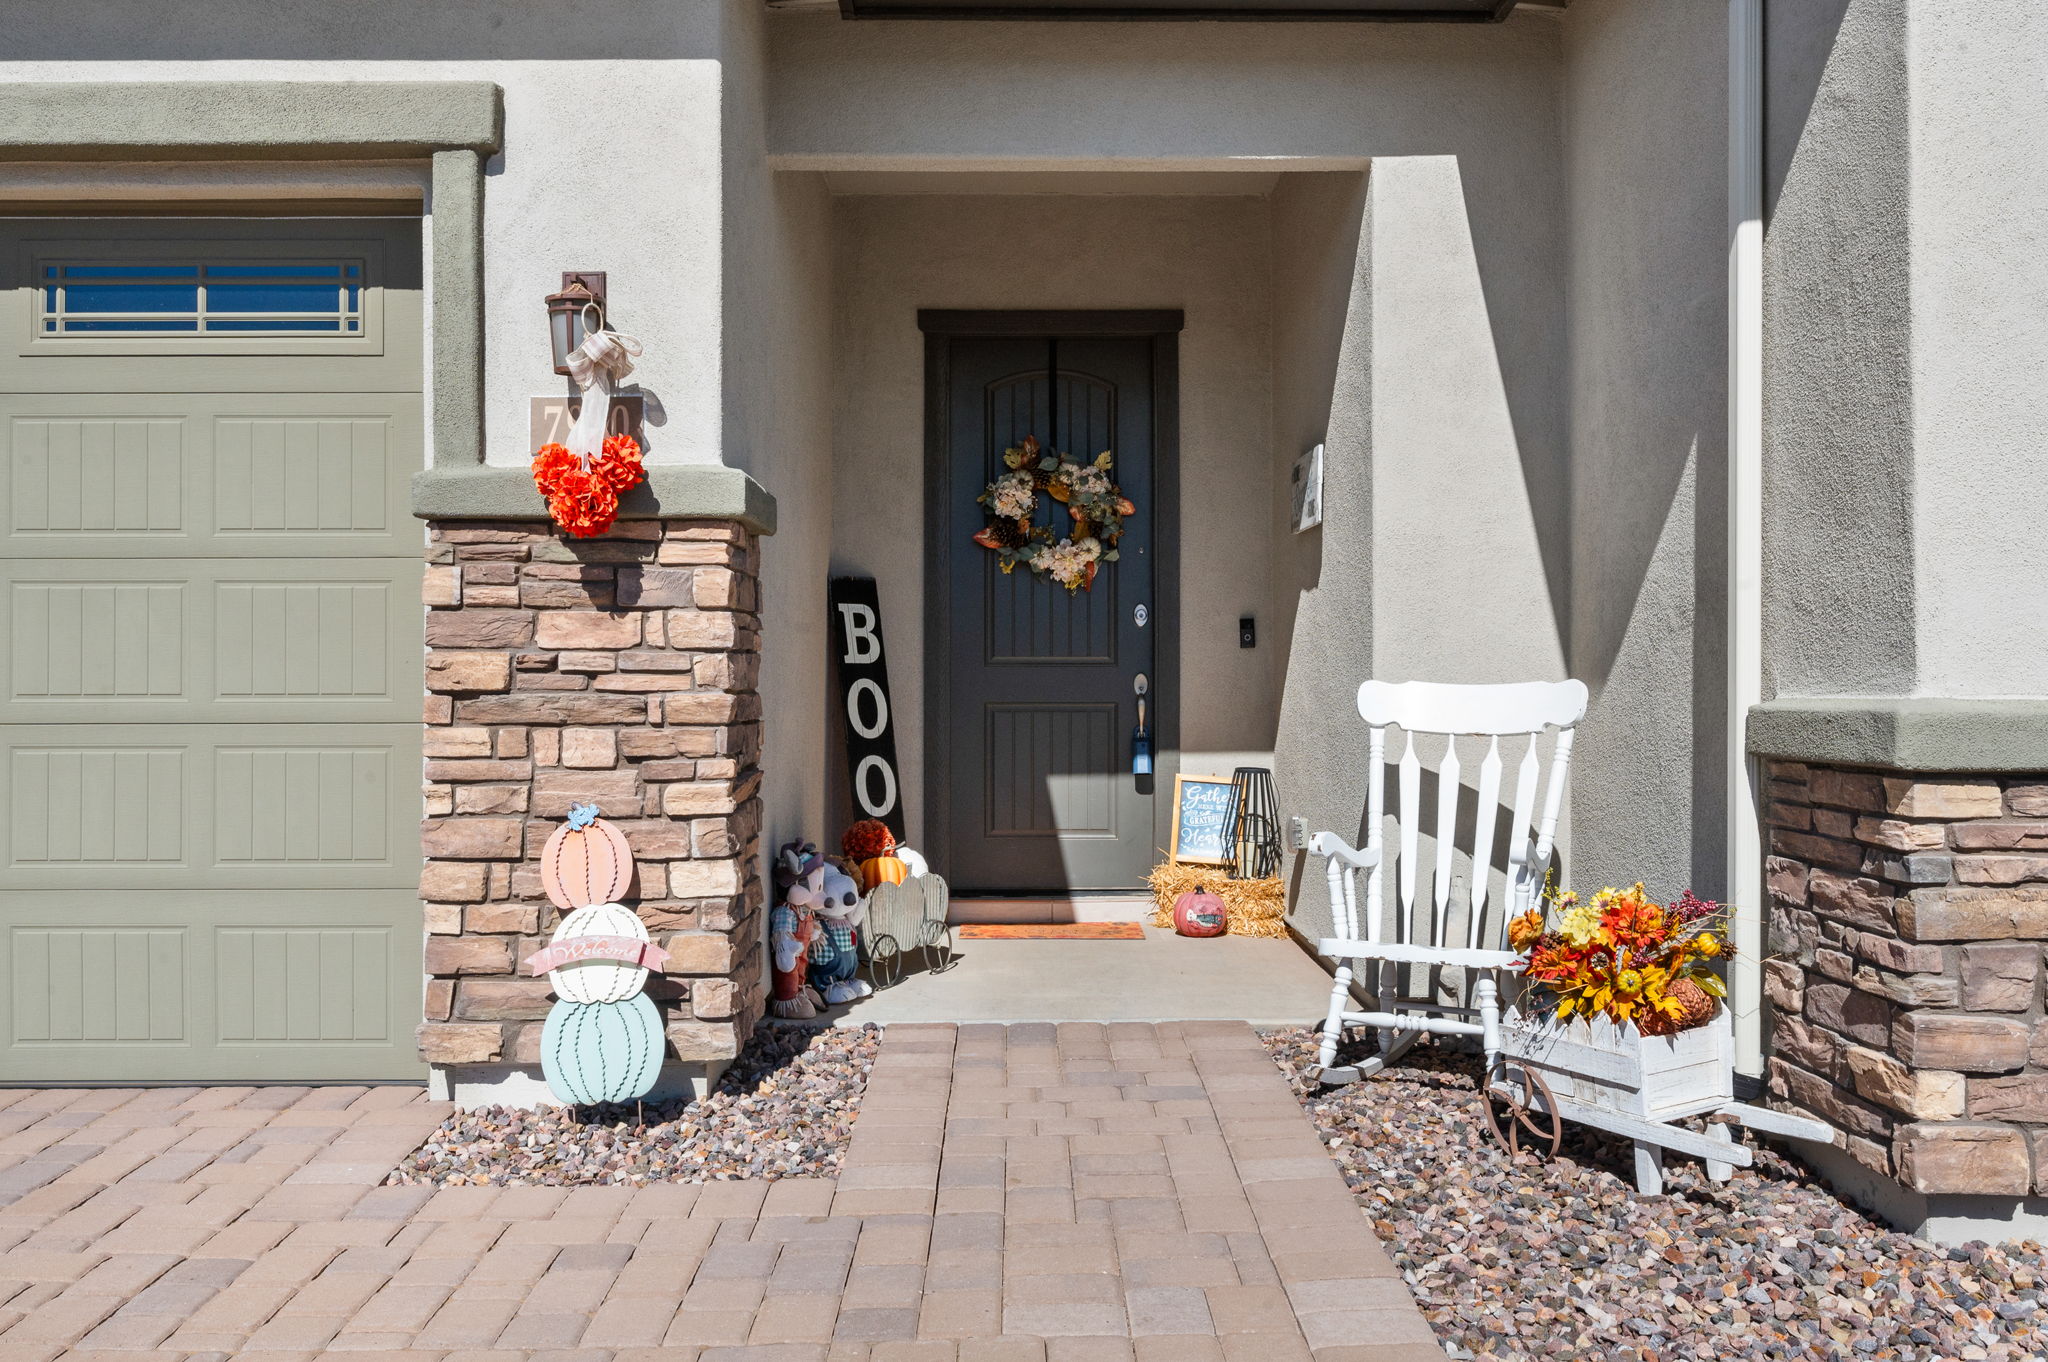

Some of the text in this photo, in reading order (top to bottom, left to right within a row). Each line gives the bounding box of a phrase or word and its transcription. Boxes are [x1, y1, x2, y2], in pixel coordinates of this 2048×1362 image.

[838, 603, 896, 817] BOO
[1184, 785, 1230, 809] Gathe
[553, 939, 639, 958] Welcome
